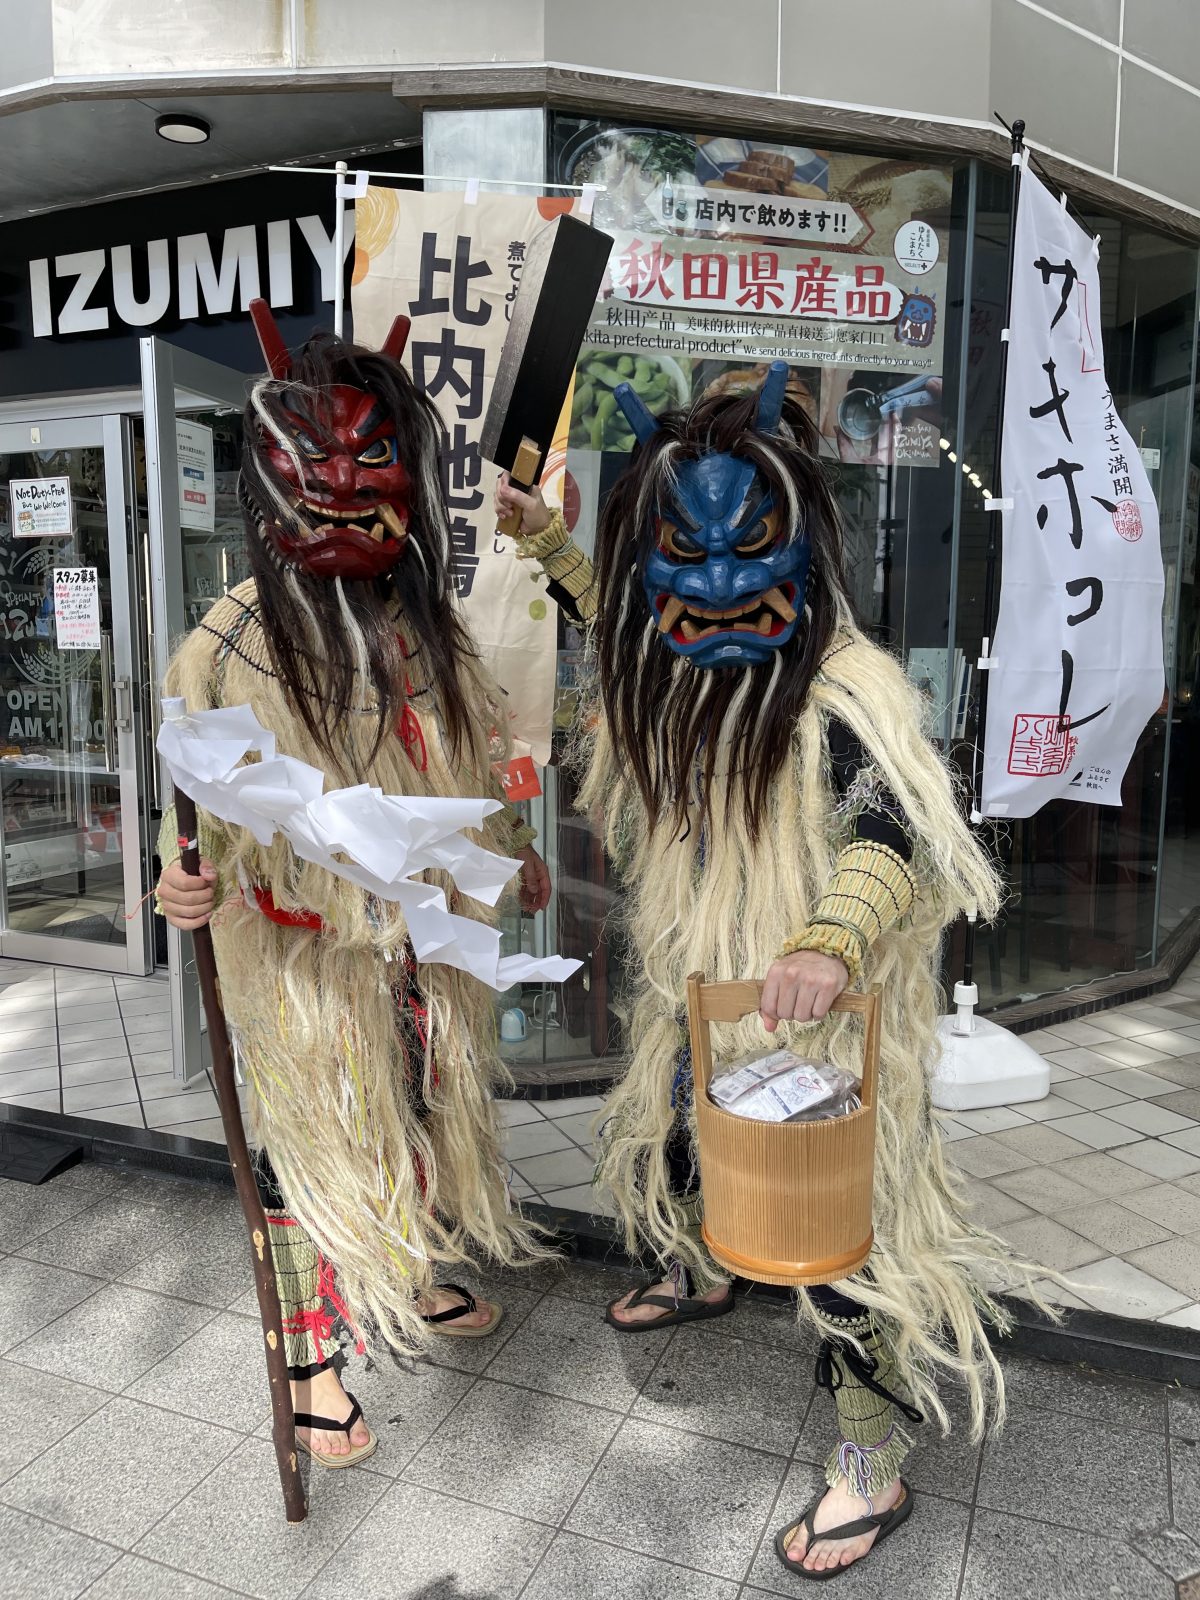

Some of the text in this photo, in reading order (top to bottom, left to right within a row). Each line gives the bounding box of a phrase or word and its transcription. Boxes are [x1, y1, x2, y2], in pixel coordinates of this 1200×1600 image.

[695, 198, 847, 233] 店内で飲めます!!
[618, 238, 893, 318] 秋田県産品
[605, 307, 675, 331] 秋田产品
[614, 333, 684, 350] prefectural
[743, 345, 757, 354] We
[759, 347, 777, 356] send
[778, 348, 810, 359] delicious
[854, 354, 884, 365] directly
[885, 356, 893, 364] to
[894, 359, 910, 367] your
[1101, 388, 1132, 496] うまさ満開
[16, 488, 30, 500] Not
[56, 569, 97, 583] スタッフ募集
[7, 690, 67, 711] OPEN
